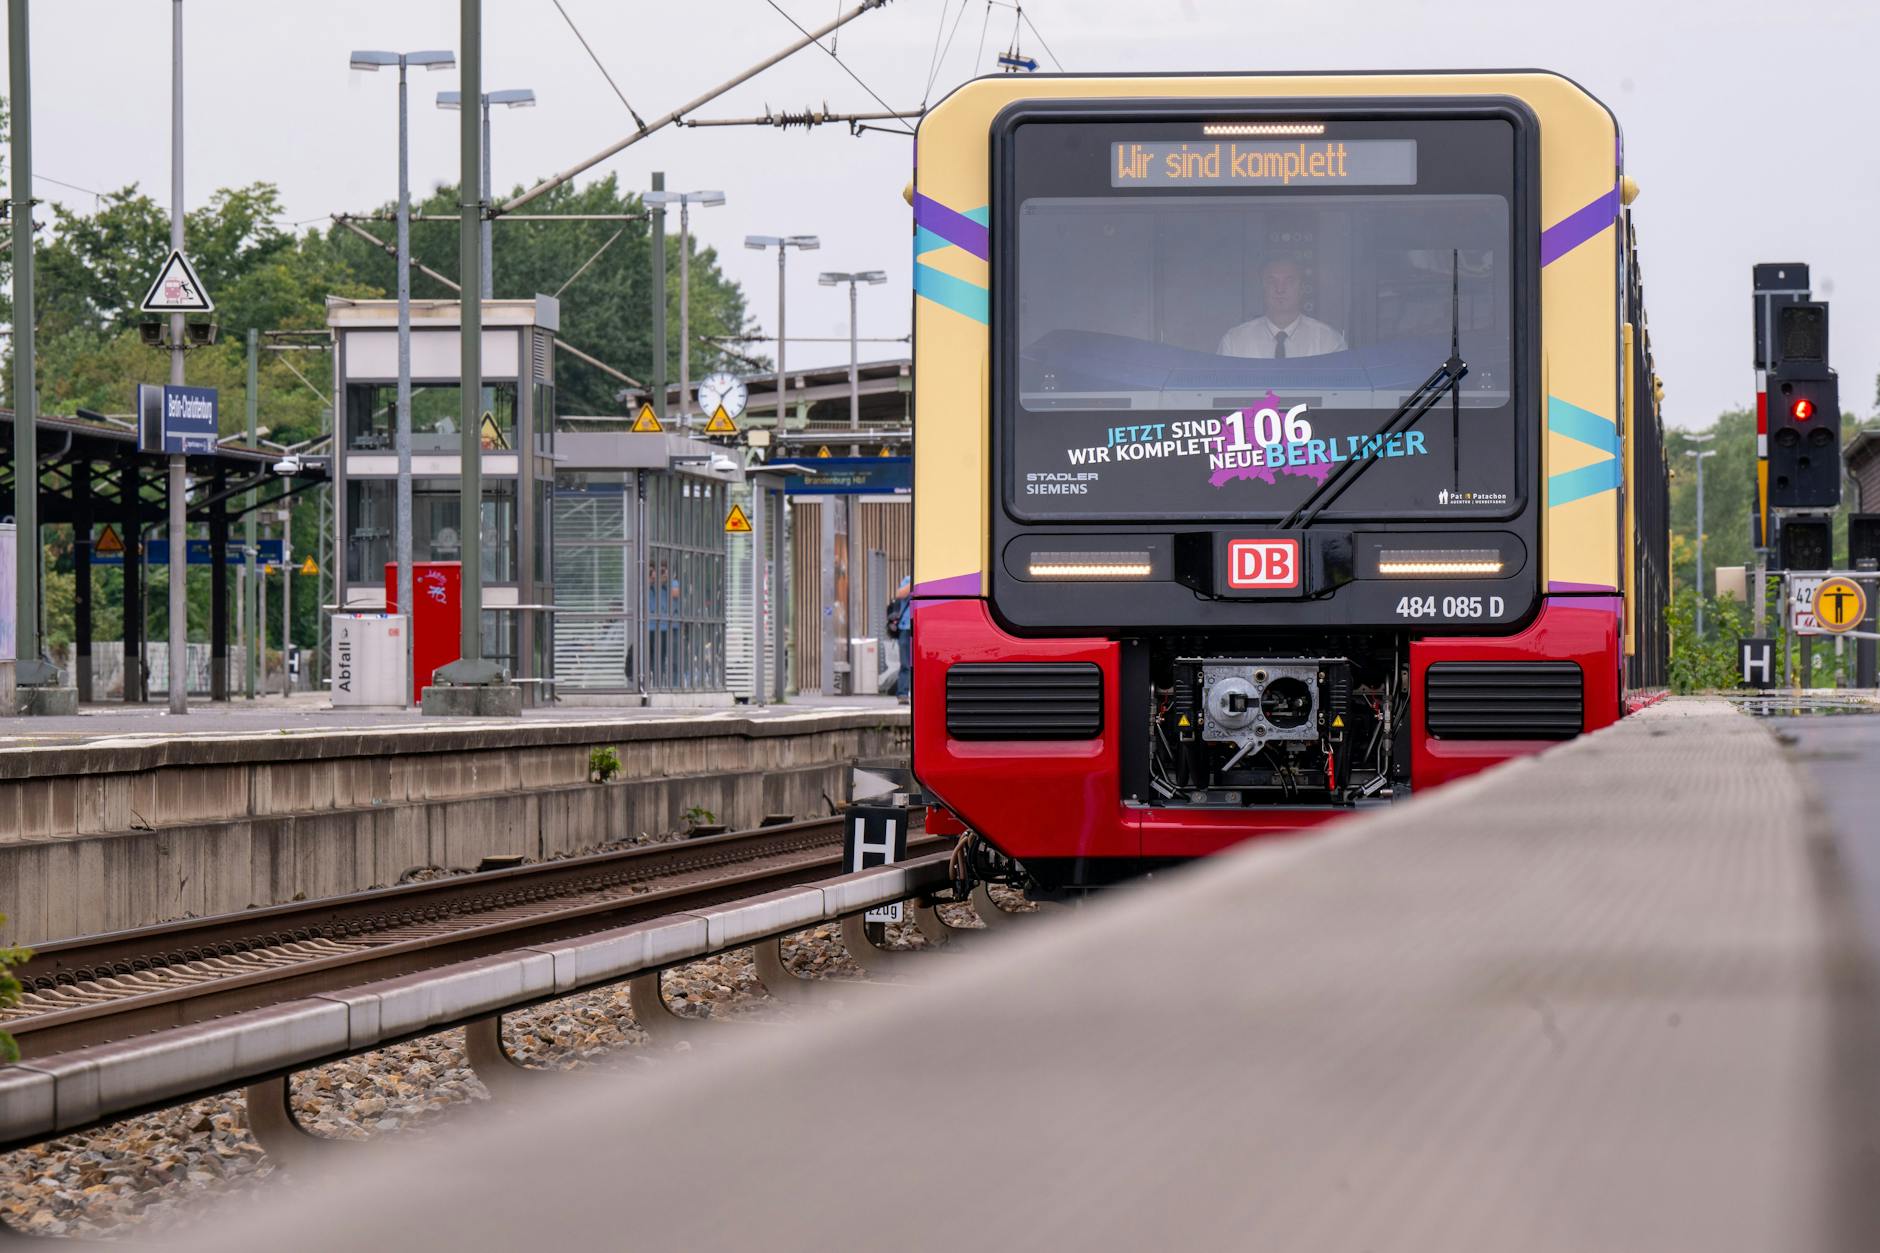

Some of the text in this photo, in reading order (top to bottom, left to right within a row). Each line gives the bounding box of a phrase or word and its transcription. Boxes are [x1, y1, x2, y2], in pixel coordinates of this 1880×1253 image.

[1117, 143, 1347, 184] Wir sind komplett
[168, 393, 213, 425] Berlin-Charlottenburg
[1107, 419, 1221, 448] JETZT SIND
[1225, 403, 1313, 452] 106
[1067, 436, 1226, 465] WIR KOMPLETT
[1208, 430, 1428, 470] NEUE BERLINER
[1026, 473, 1099, 481] STADLER
[1026, 484, 1088, 495] SIEMENS
[1236, 546, 1291, 581] DB
[1396, 596, 1505, 618] 484 085 D
[1796, 587, 1817, 603] 42
[338, 641, 351, 693] Abfall
[1743, 645, 1771, 683] H
[853, 817, 897, 873] H
